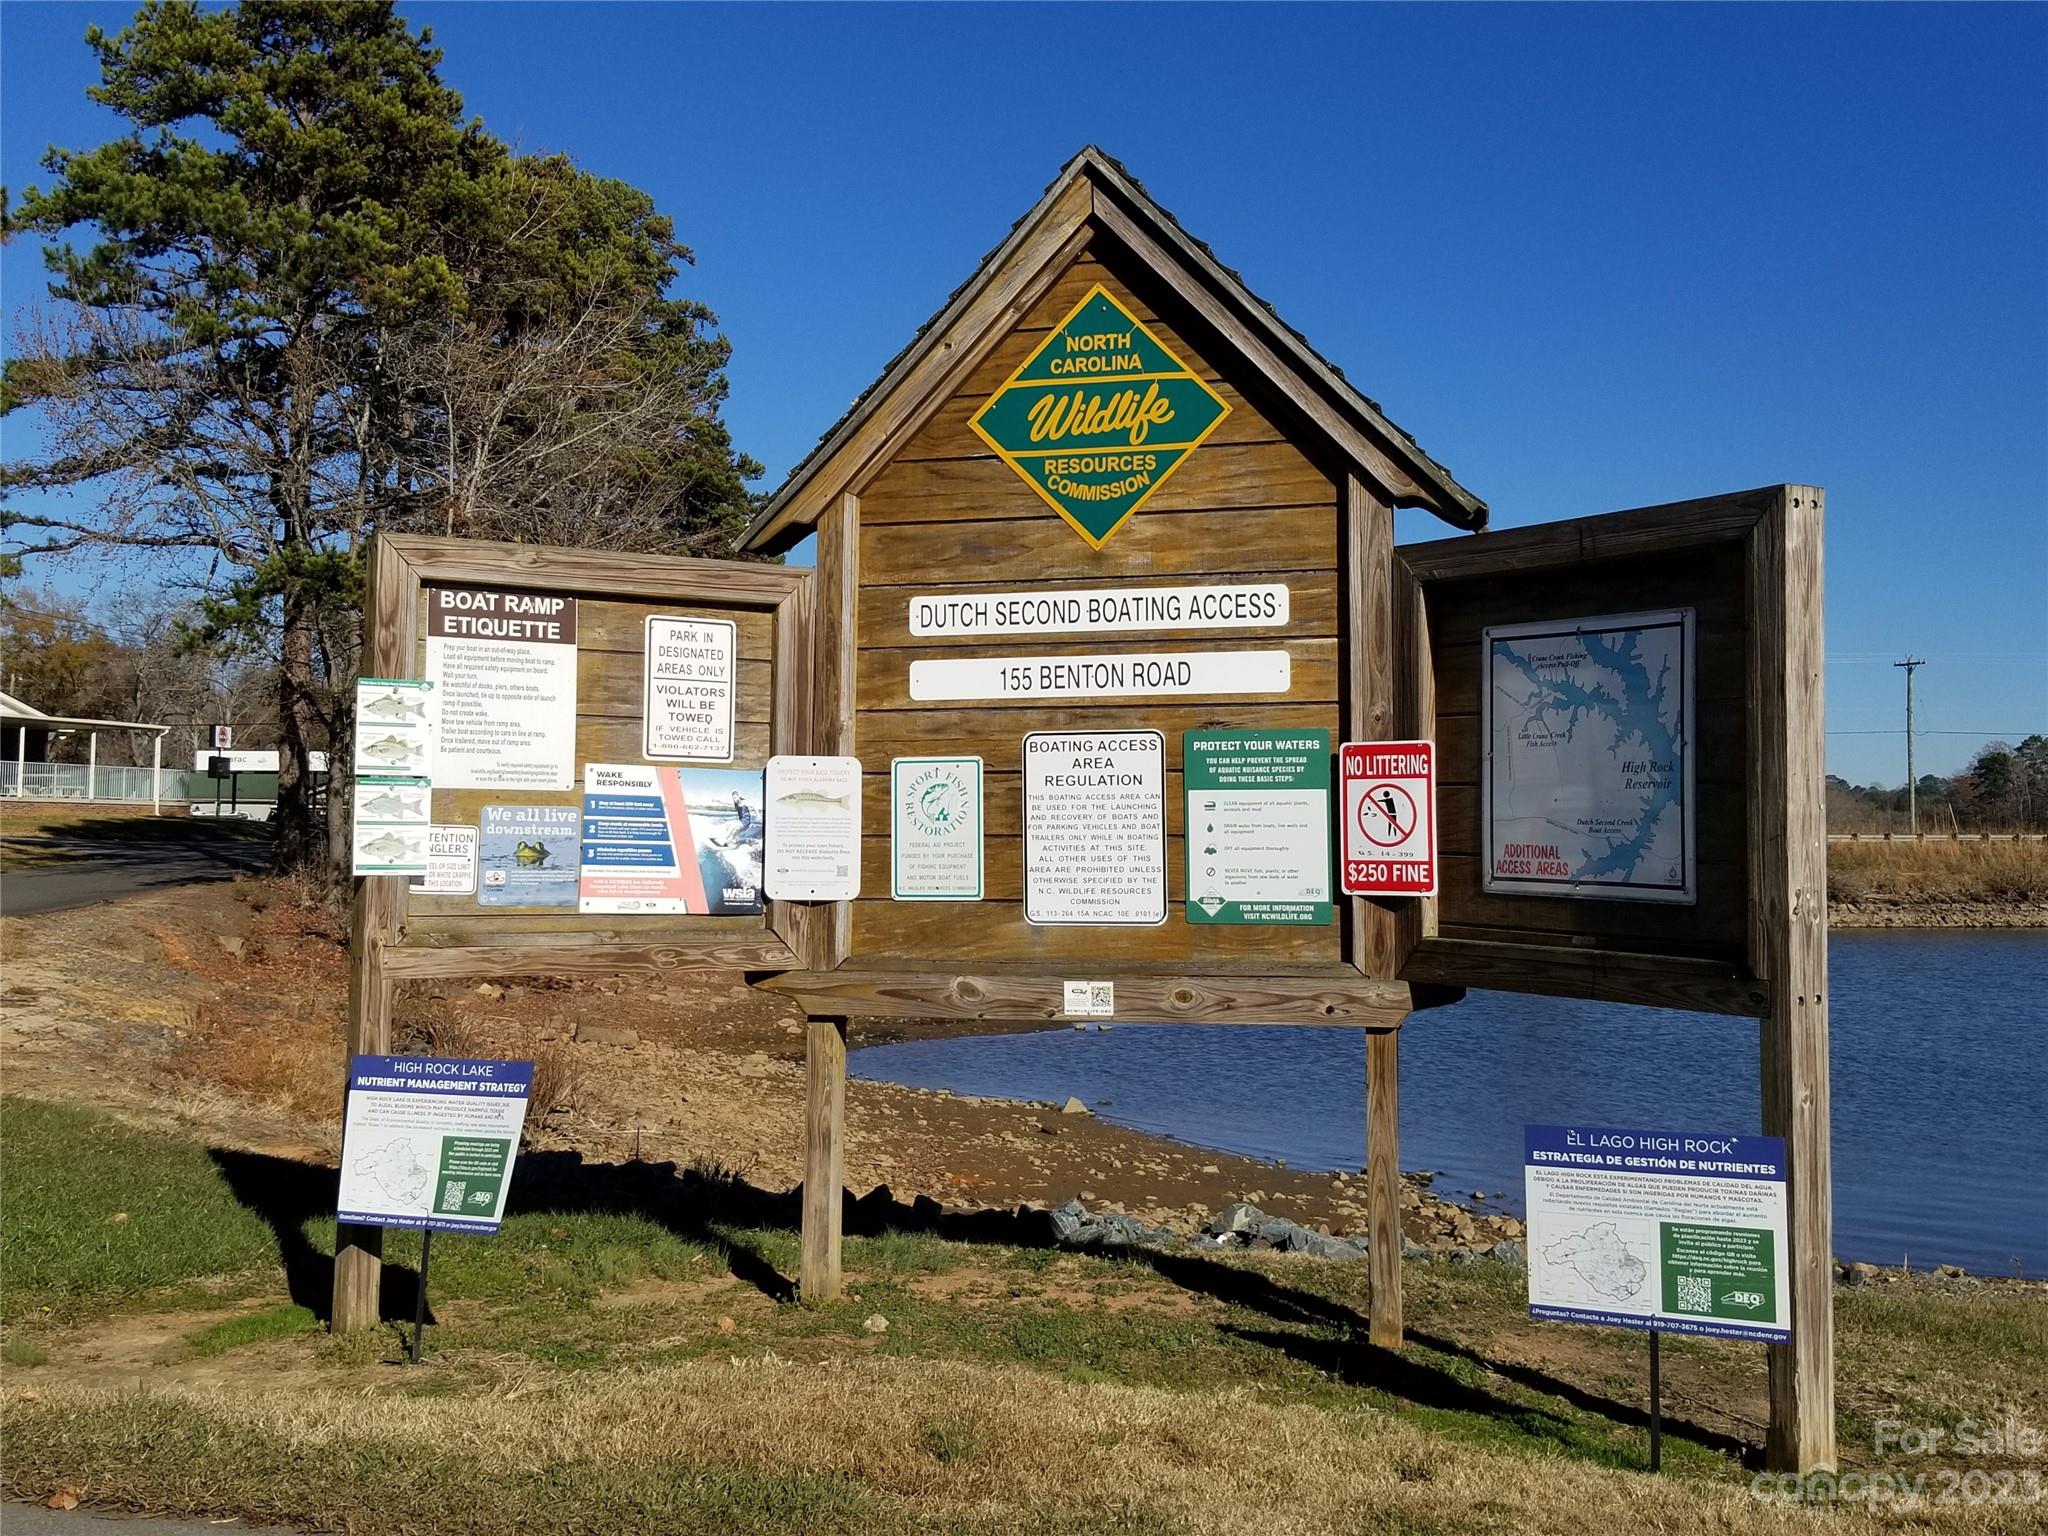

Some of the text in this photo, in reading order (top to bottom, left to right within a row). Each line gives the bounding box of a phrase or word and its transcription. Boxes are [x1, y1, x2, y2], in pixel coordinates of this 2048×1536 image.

[1066, 333, 1131, 352] NORTH
[1050, 355, 1142, 374] CAROLINA
[1027, 383, 1175, 446] Wildlife
[1044, 455, 1156, 474] RESOURCES
[1047, 472, 1150, 502] COMMISSION
[440, 592, 565, 616] BOAT RAMP
[919, 594, 1276, 628] DUTCH SECOND BOATING ACCESS
[444, 616, 561, 639] ETIQUETTE
[670, 630, 713, 643] PARK IN
[658, 646, 724, 660] DESIGNATED
[657, 663, 725, 677] AREAS ONLY
[1000, 661, 1191, 691] 155 BENTON ROAD
[656, 685, 726, 697] VIOLATORS
[666, 700, 715, 710] WILL BE
[668, 712, 713, 722] TOWED
[669, 726, 709, 734] VEHICLE
[658, 734, 693, 742] TOWED
[1029, 740, 1158, 752] BOATING ACCESS
[1193, 740, 1320, 751] PROTECT YOUR WATERS
[1072, 758, 1114, 769] AREA
[1346, 755, 1428, 776] NO LITTERING
[1622, 762, 1674, 775] High Rock
[596, 771, 623, 779] WAKE
[1044, 775, 1143, 786] REGULATION
[596, 779, 653, 788] RESPONSIBLY
[908, 769, 969, 800] SPORT FISH
[1625, 779, 1672, 790] Reservoir
[590, 801, 596, 809] 1
[487, 807, 577, 823] We all live
[905, 800, 969, 836] RESTORATION
[486, 824, 576, 837] downstream.
[589, 825, 596, 834] 2
[429, 833, 474, 843] TENTION
[429, 844, 468, 853] NGLERS
[587, 849, 594, 858] 3
[1503, 845, 1560, 859] ADDITIONAL
[1348, 863, 1430, 883] $250 FINE
[1496, 860, 1568, 876] ACCESS AREAS
[723, 887, 755, 899] wsia
[394, 1062, 493, 1076] HIGH ROCK LAKE
[357, 1077, 526, 1092] NUTRIENT MANAGEMENT STRATEGY
[1567, 1133, 1732, 1154] EL LAGO HIGH ROCK
[1533, 1151, 1776, 1175] ESTRATEGIA DE GESTIÓN DE NUTRIENTES
[1735, 1293, 1760, 1305] DEQ
[1532, 1308, 1569, 1318] ¿Preguntas?
[1570, 1312, 1599, 1320] Contacte
[1606, 1315, 1621, 1324] Joey
[1622, 1317, 1644, 1325] Hester
[1653, 1320, 1697, 1330] 919-707-3675
